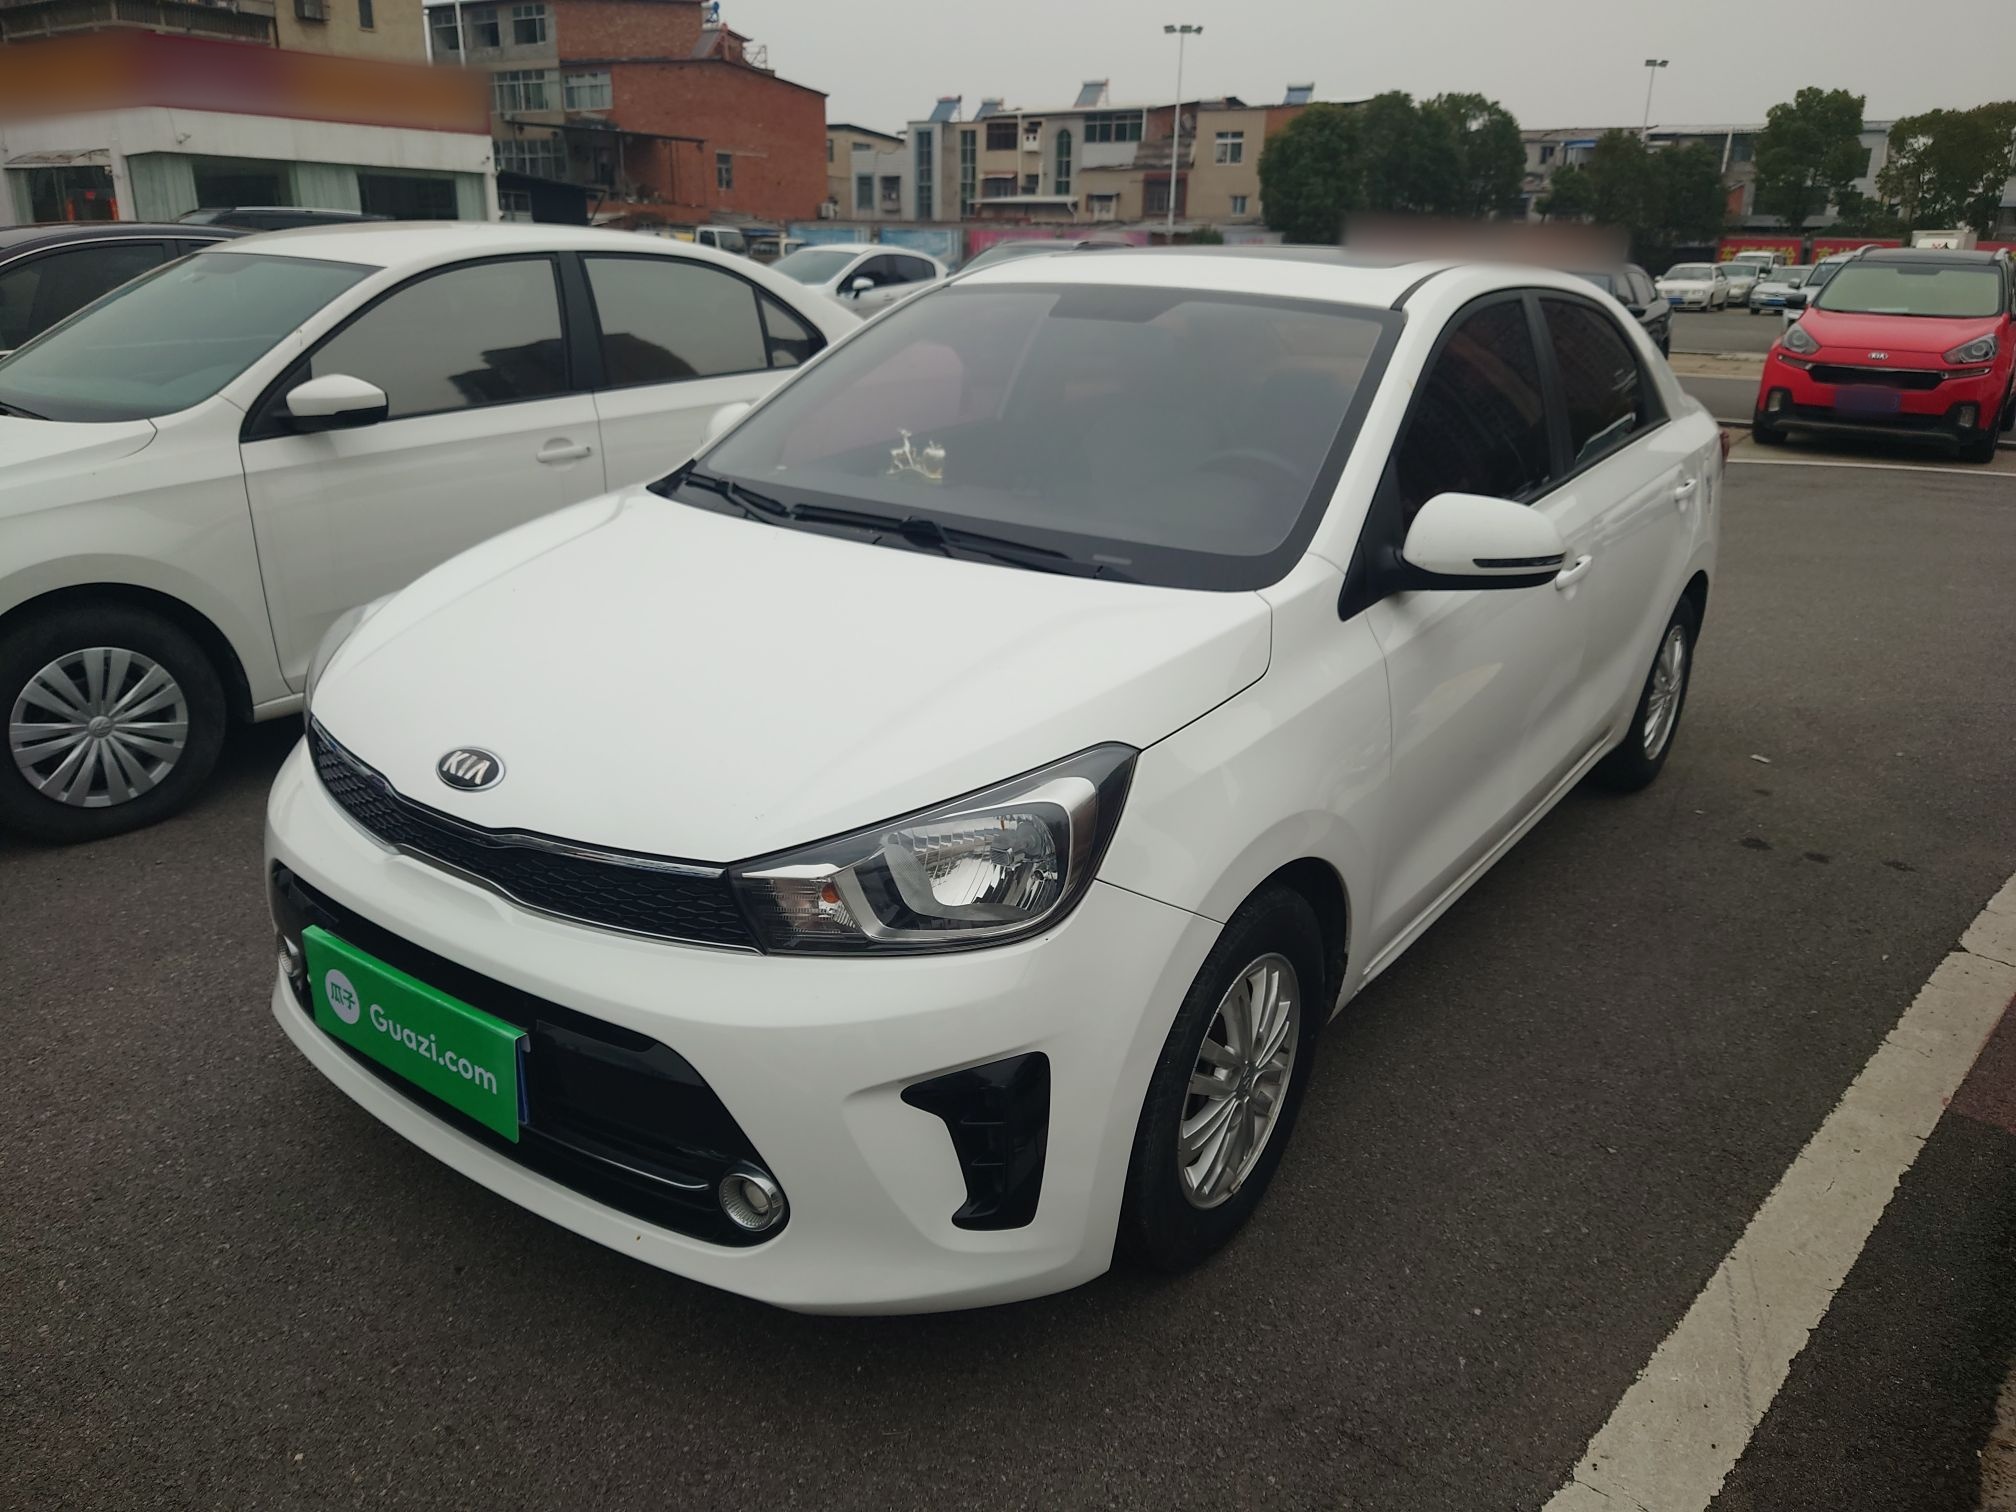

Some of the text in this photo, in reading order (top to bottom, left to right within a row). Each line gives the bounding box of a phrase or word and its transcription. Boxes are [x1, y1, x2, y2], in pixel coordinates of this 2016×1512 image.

[1869, 351, 1888, 360] KIA
[442, 750, 491, 785] KIA
[331, 982, 356, 1010] 瓜子
[370, 1004, 497, 1095] Guazi.com
